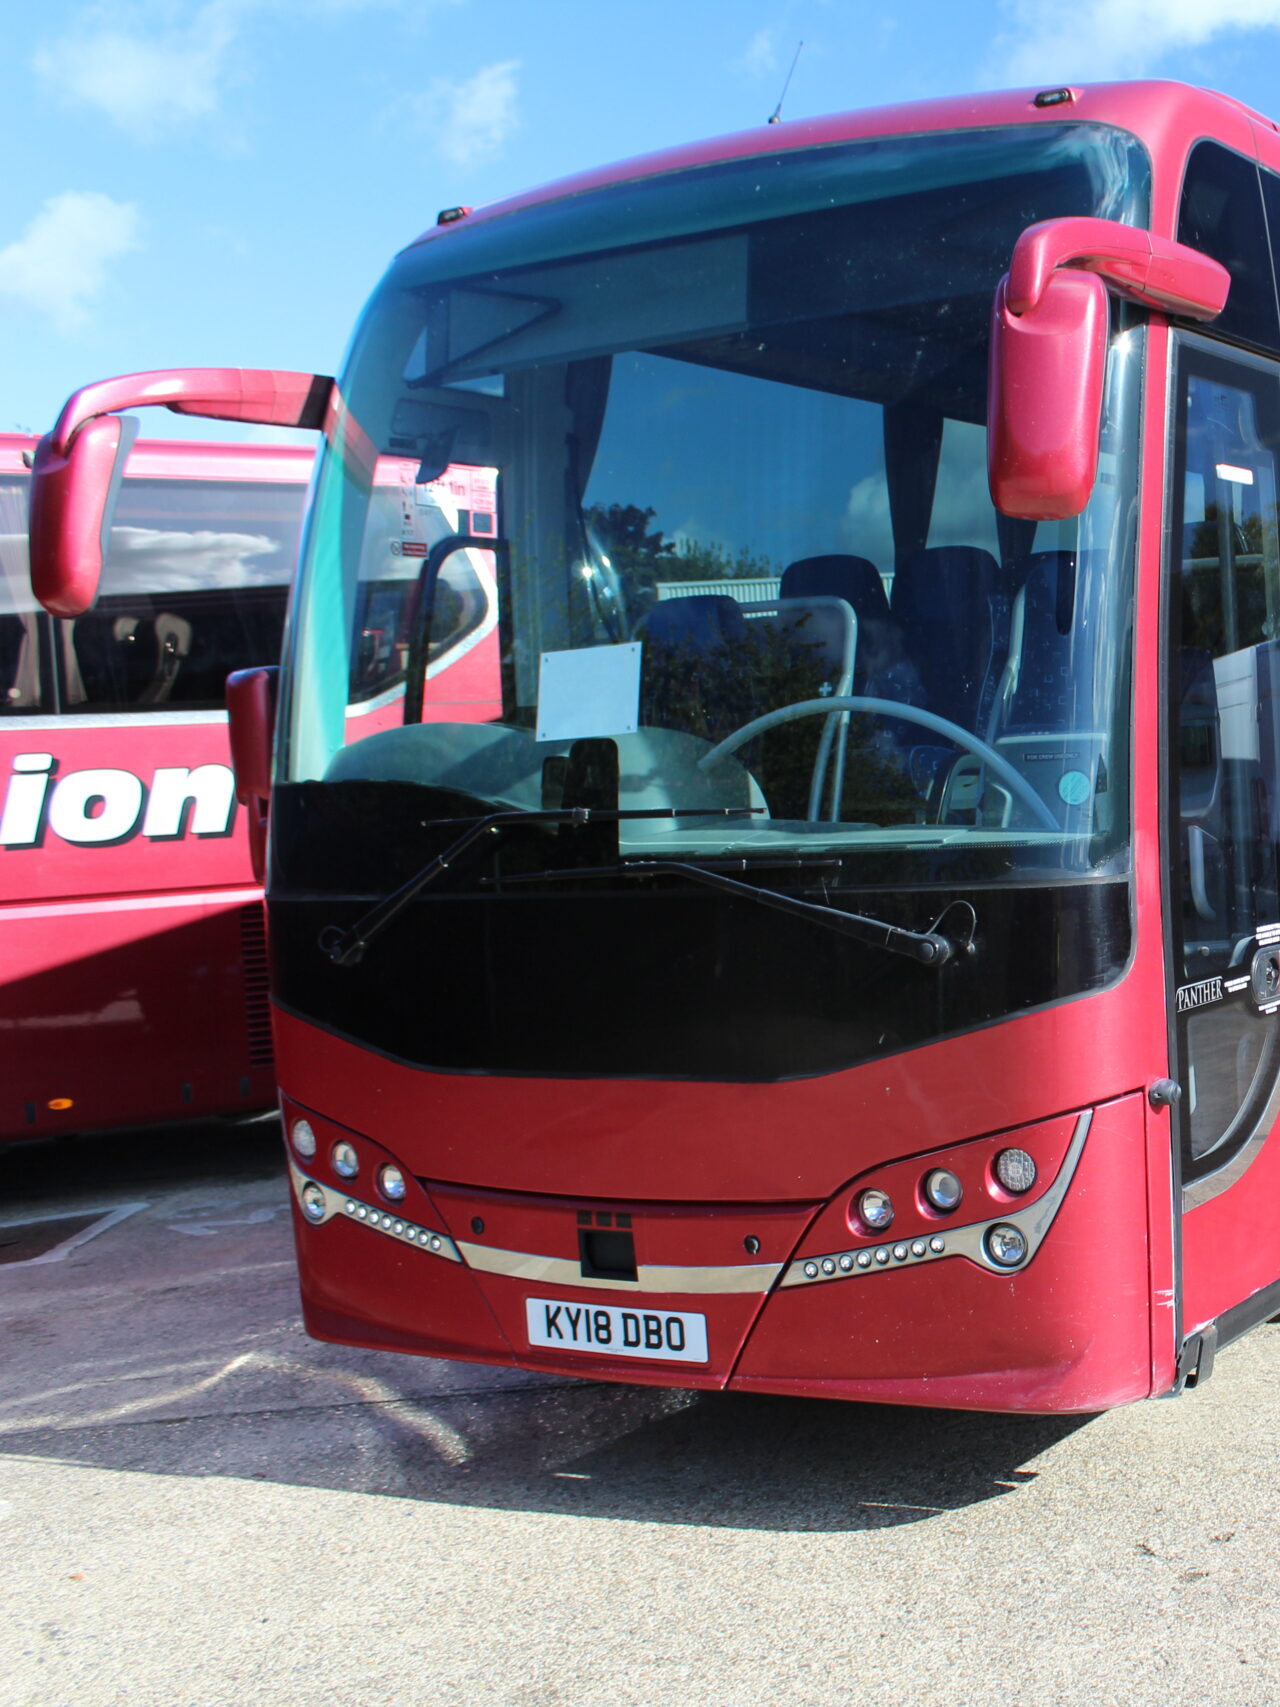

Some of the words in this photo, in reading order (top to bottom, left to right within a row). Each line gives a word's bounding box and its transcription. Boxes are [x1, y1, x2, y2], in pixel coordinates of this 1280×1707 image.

[1177, 978, 1223, 1010] PANTHER
[545, 1304, 612, 1345] KY18
[621, 1312, 686, 1352] DBO
